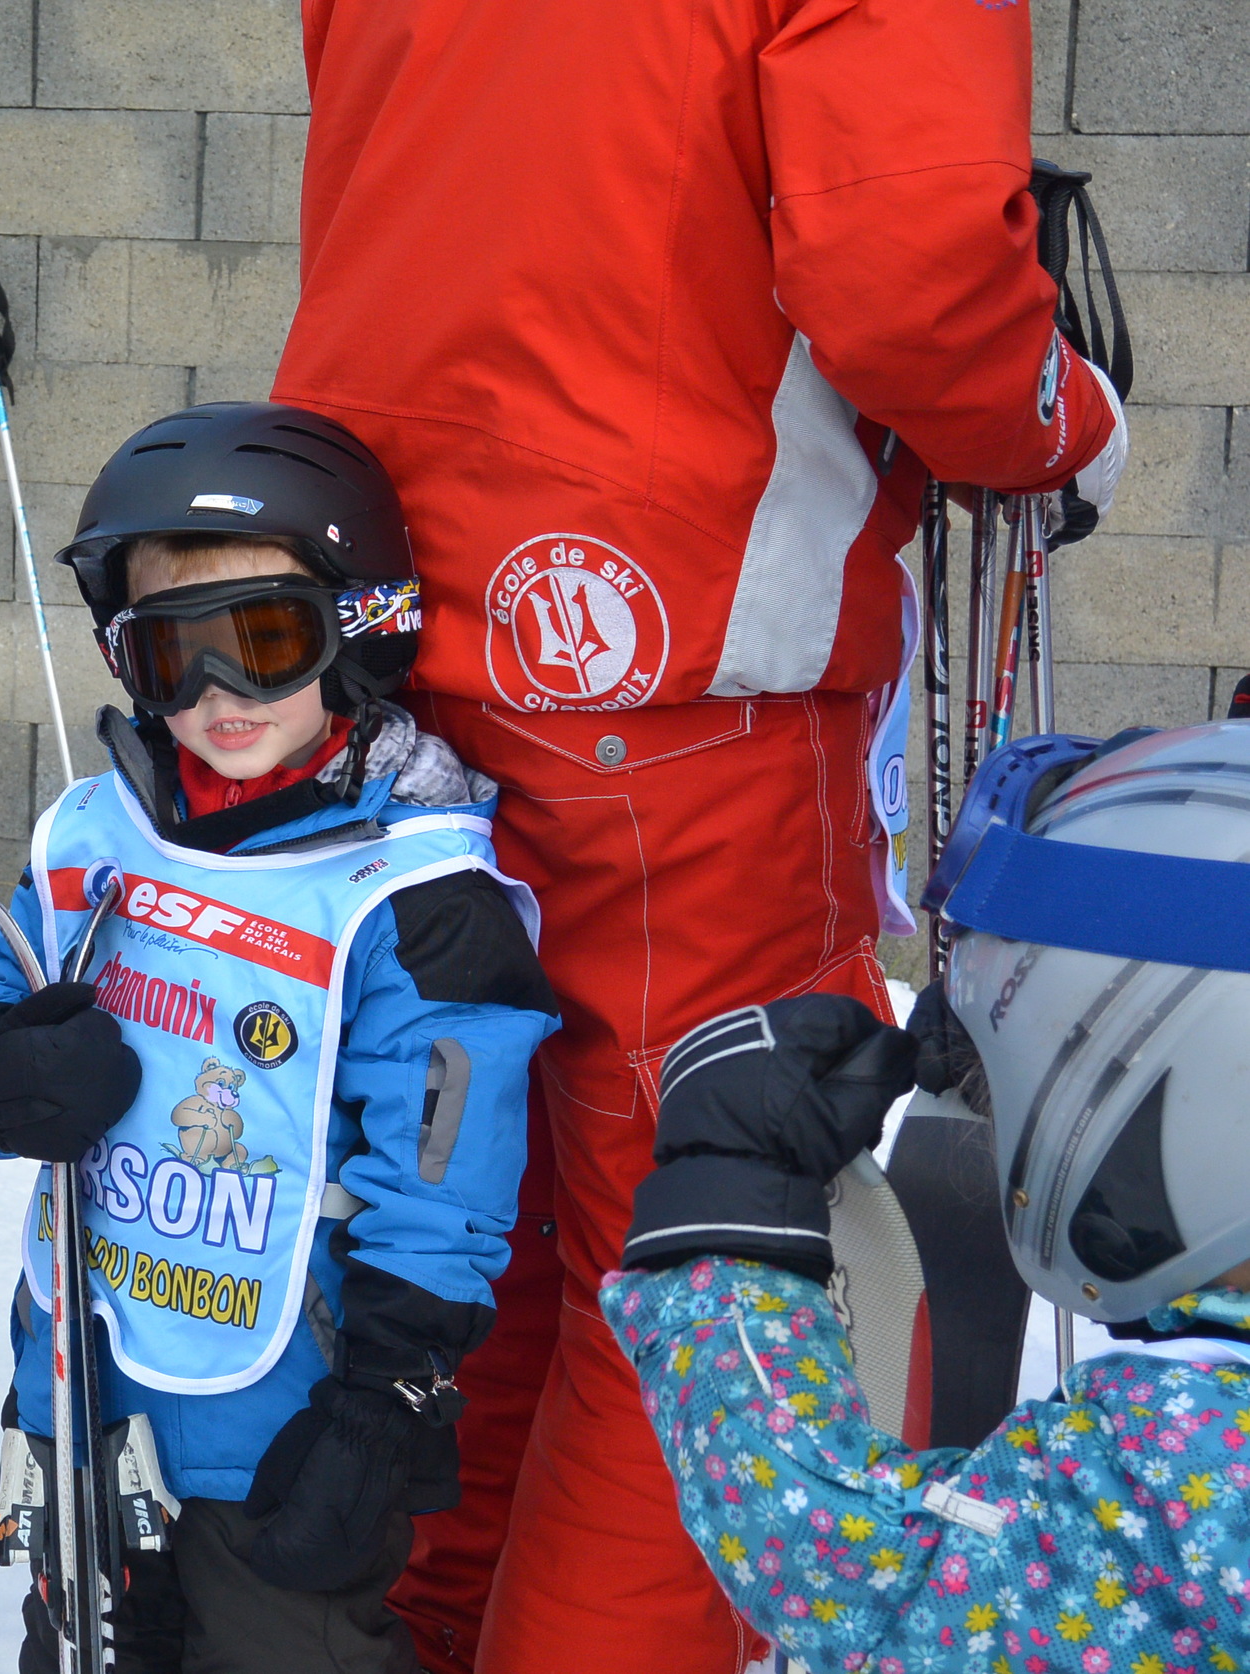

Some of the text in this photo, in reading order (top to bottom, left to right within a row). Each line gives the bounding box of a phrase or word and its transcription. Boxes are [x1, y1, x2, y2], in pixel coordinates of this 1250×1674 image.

[492, 542, 645, 624] école de ski
[244, 928, 289, 947] DU SKI
[250, 920, 287, 938] ÉCOLE
[239, 934, 302, 961] FRANÇAIS
[93, 951, 217, 1045] chamonix
[248, 1002, 292, 1025] école de ski
[244, 1052, 283, 1069] chamonix
[78, 1136, 277, 1255] RSON
[129, 1251, 262, 1330] BONBON
